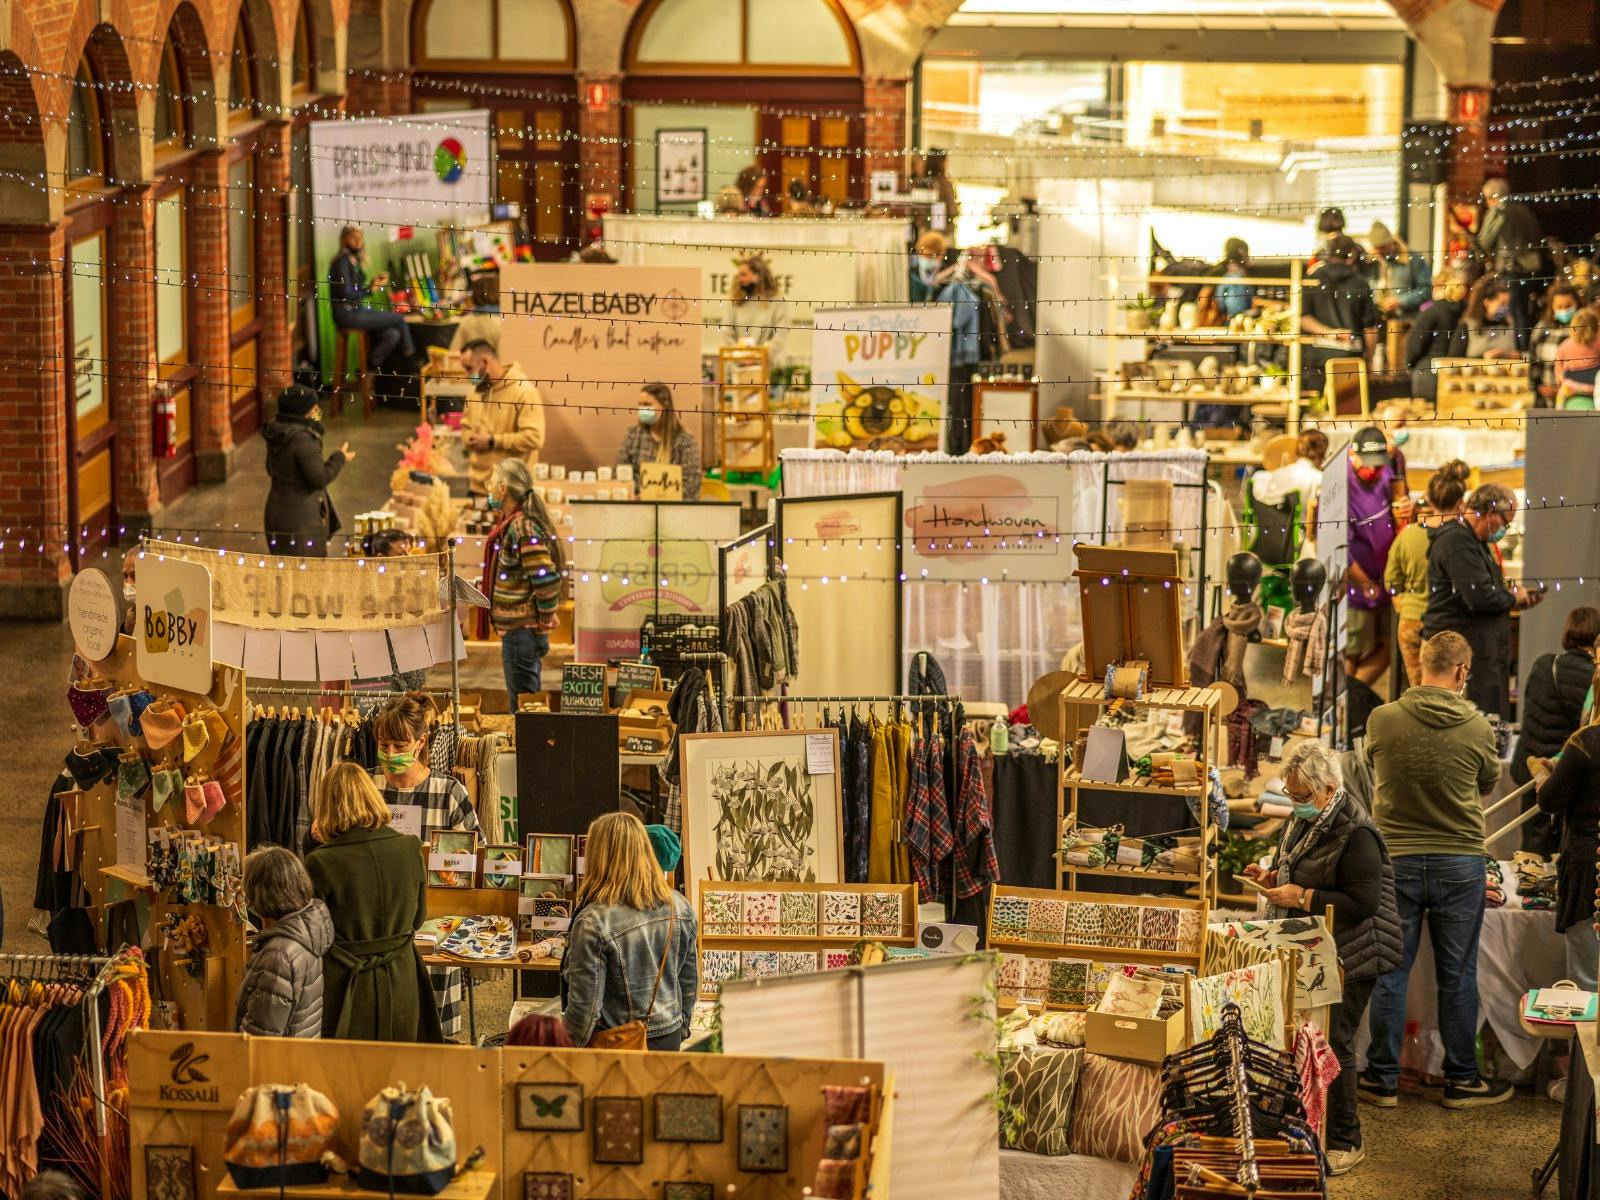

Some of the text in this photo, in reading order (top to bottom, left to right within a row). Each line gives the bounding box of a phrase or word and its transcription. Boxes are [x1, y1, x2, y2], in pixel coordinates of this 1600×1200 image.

[512, 291, 656, 315] HAZELBABY
[543, 325, 686, 355] Candles that inspire
[844, 331, 928, 362] PUPPY
[922, 503, 1046, 529] Handwoven
[77, 607, 109, 623] handmade
[82, 625, 105, 639] organic
[145, 604, 198, 647] BOBBY
[87, 636, 101, 652] local
[563, 666, 604, 681] FRESH
[562, 681, 603, 695] EXOTIC
[561, 696, 605, 708] MUSHROOMS
